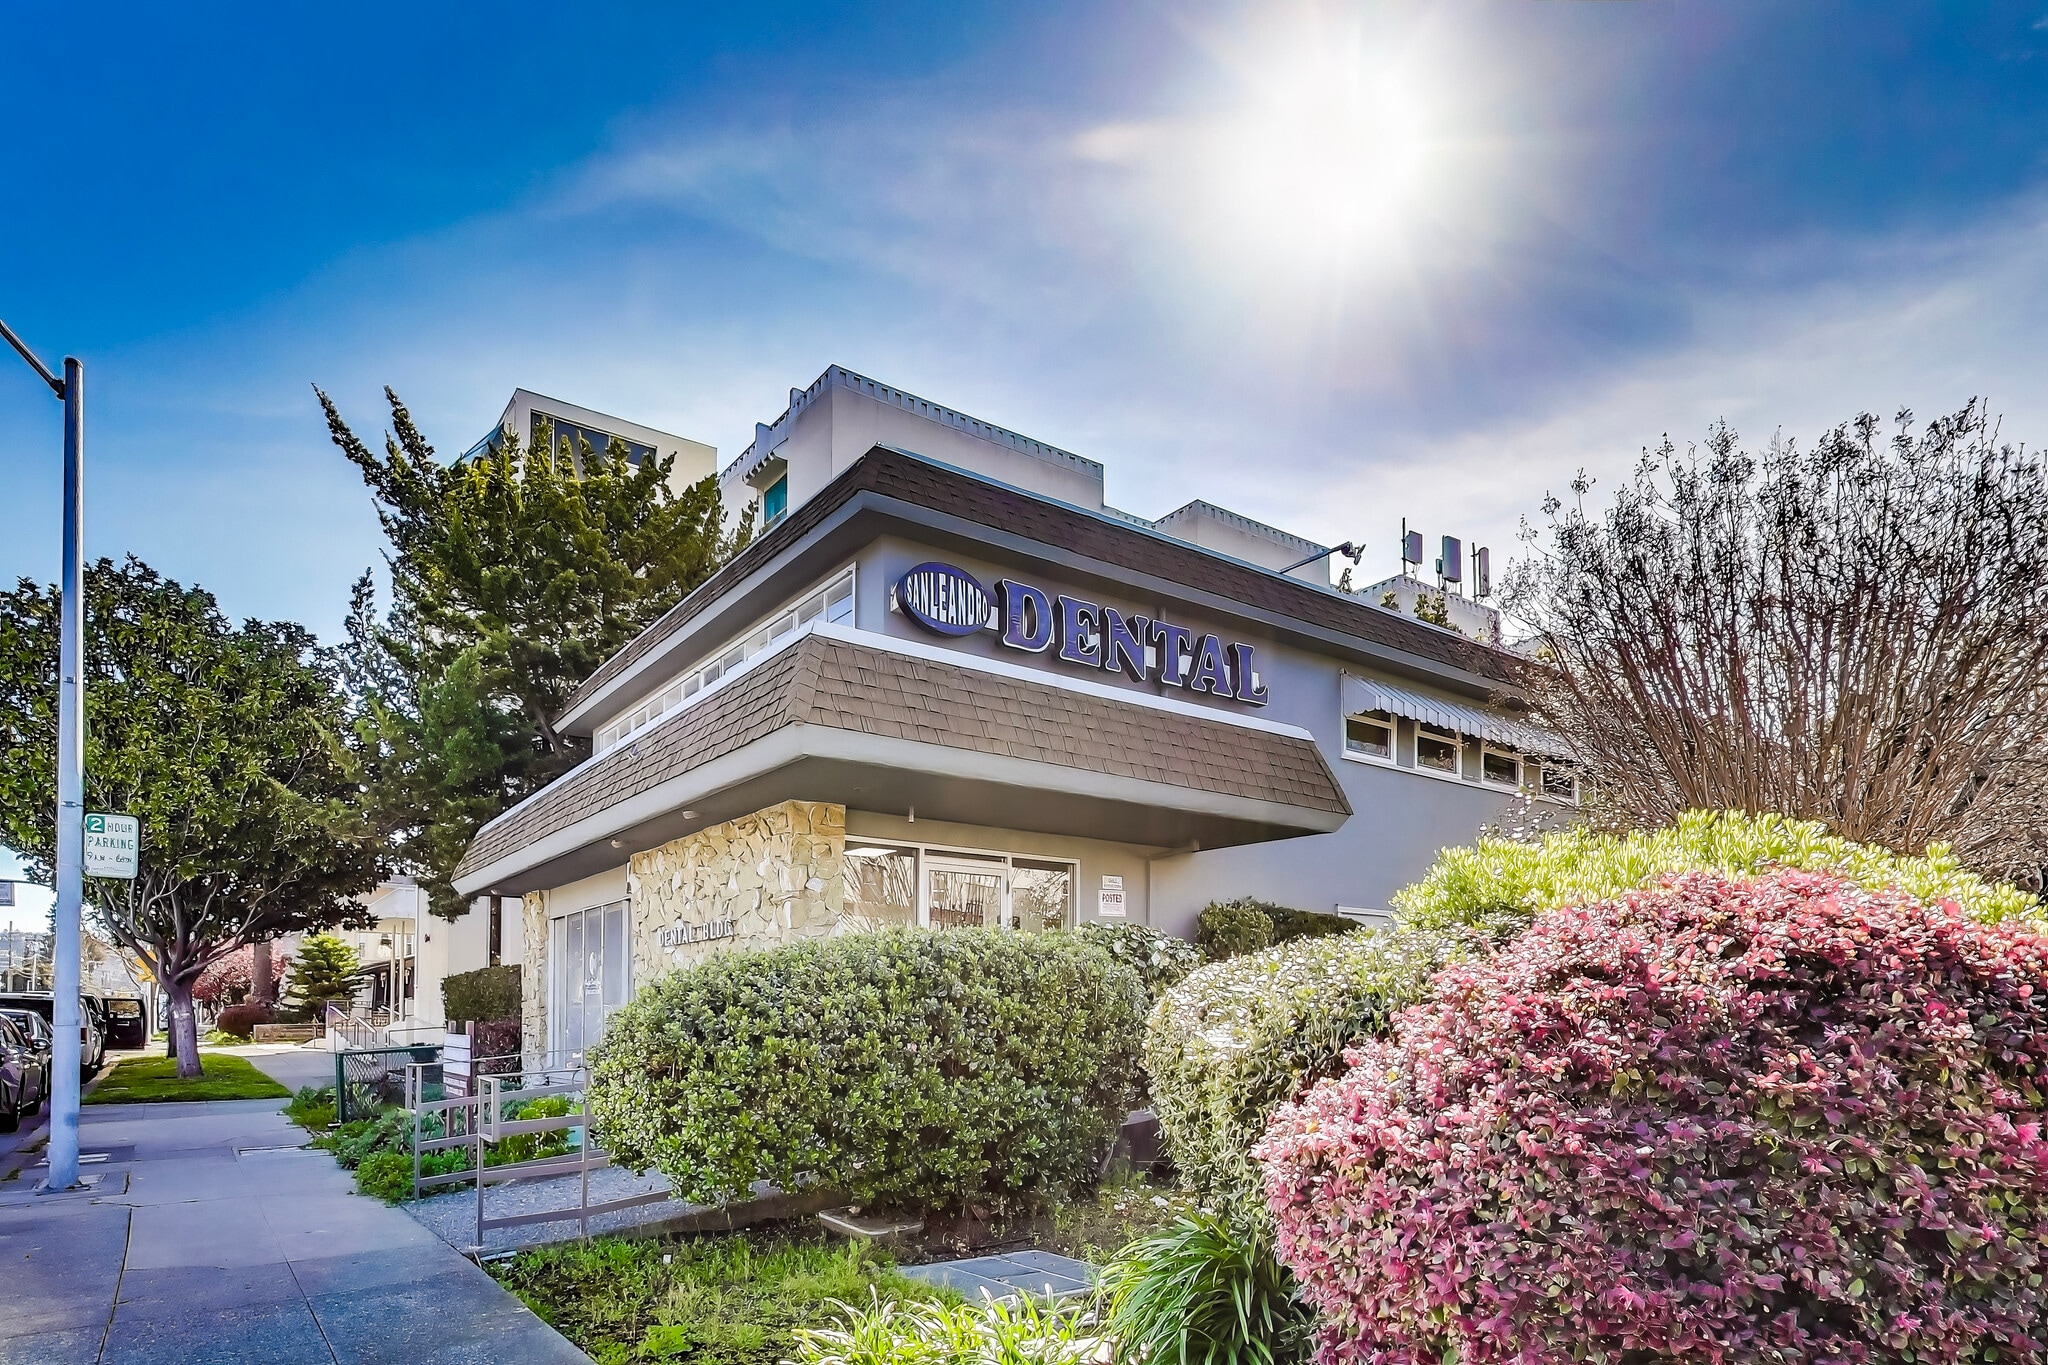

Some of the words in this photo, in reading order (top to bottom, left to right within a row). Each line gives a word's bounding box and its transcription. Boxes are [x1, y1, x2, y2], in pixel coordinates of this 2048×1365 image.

[998, 578, 1268, 706] DENTAL
[90, 817, 103, 831] 2
[107, 822, 133, 833] HOUR
[88, 836, 134, 850] PARKING
[1102, 893, 1122, 903] POSTED
[658, 923, 695, 947] DENTAL
[703, 920, 733, 940] BLDG
